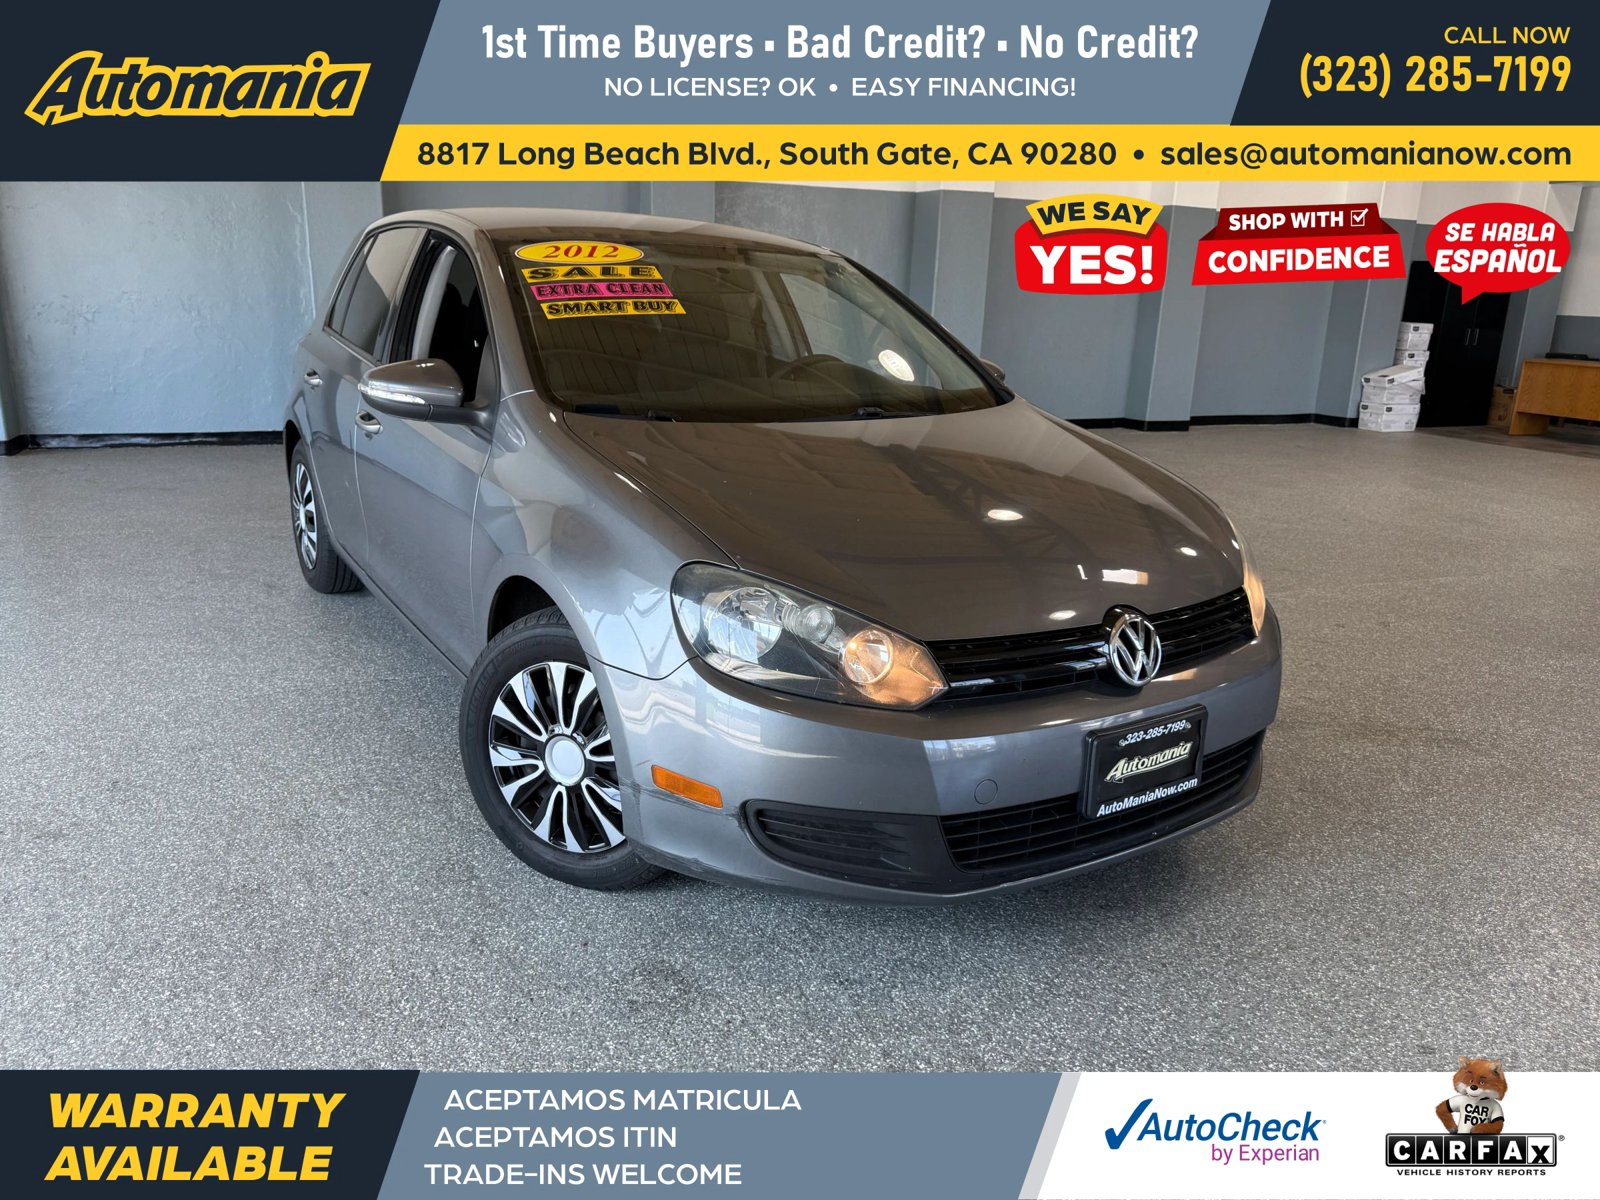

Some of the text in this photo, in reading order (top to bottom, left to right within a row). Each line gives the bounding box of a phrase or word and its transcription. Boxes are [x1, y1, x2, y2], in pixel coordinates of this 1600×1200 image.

[542, 244, 620, 259] 2012
[527, 266, 657, 280] SALE
[536, 282, 667, 297] EXTRA CLEAN
[546, 299, 679, 316] SMART BUY
[1124, 719, 1186, 744] 323-285-7199
[1104, 740, 1194, 783] Automania
[1096, 777, 1198, 817] AutoManiaNow.com
